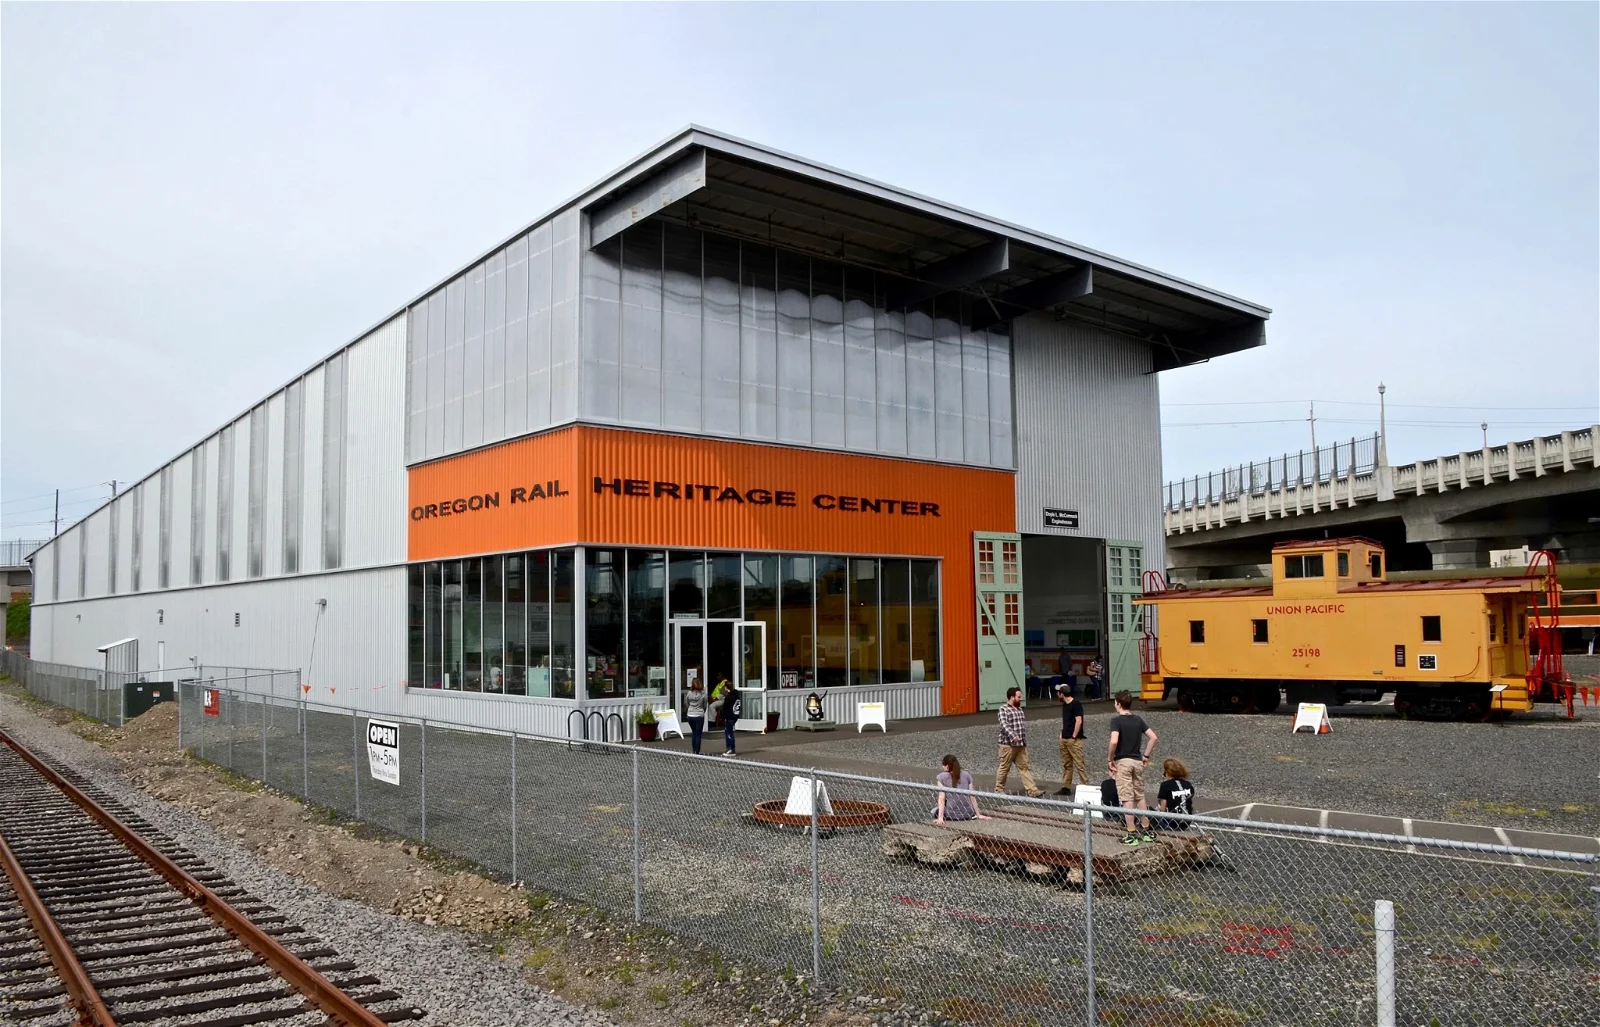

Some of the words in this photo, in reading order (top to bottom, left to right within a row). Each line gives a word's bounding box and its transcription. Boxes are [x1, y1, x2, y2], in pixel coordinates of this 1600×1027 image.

[411, 491, 500, 521] OREGON
[510, 479, 569, 503] RAIL
[593, 476, 797, 508] HERITAGE
[812, 493, 941, 518] CENTER
[1266, 605, 1302, 615] UNION
[1305, 604, 1345, 614] PACIFIC
[1292, 648, 1321, 658] 25198
[781, 673, 797, 687] OPEN
[370, 725, 395, 746] OPEN
